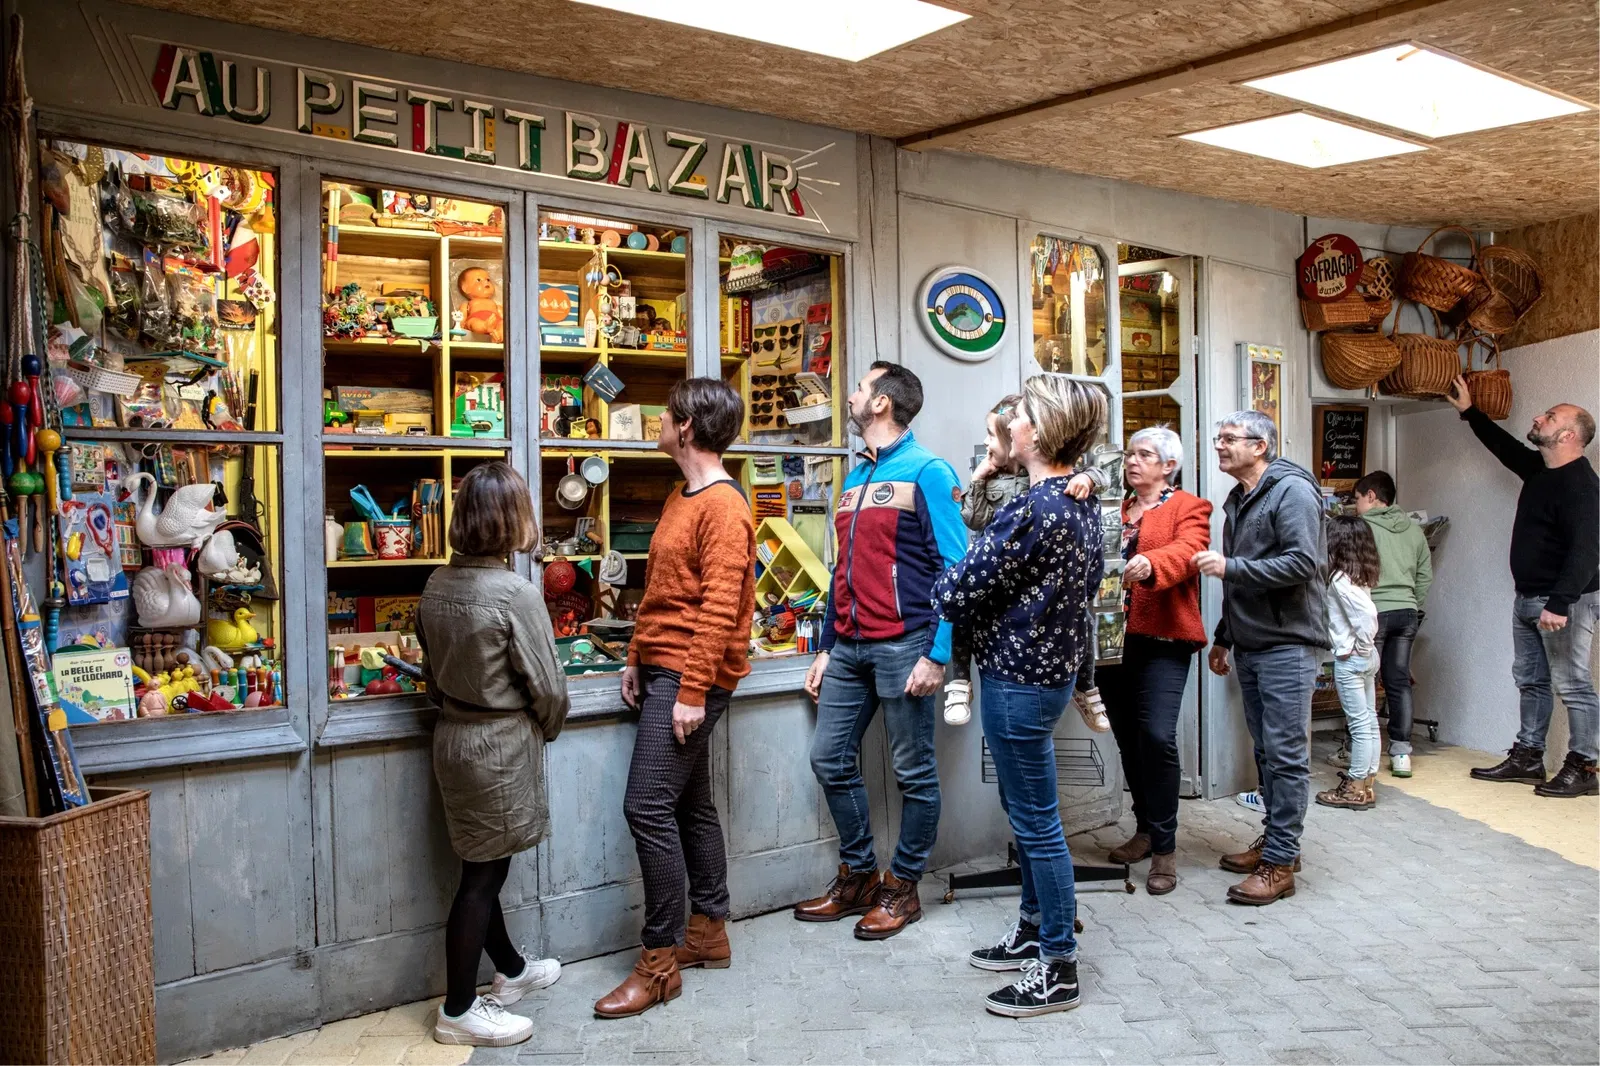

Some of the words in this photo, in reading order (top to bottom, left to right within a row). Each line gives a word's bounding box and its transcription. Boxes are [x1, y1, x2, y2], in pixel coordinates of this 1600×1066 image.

[162, 46, 271, 124] AU
[297, 67, 546, 171] PETIT
[565, 111, 800, 215] BAZAR
[1304, 253, 1357, 284] SOFRAGAZ
[1319, 281, 1345, 295] BUTANE
[70, 666, 94, 675] BELLE
[95, 665, 103, 673] ET
[82, 670, 123, 682] CLOCHARD
